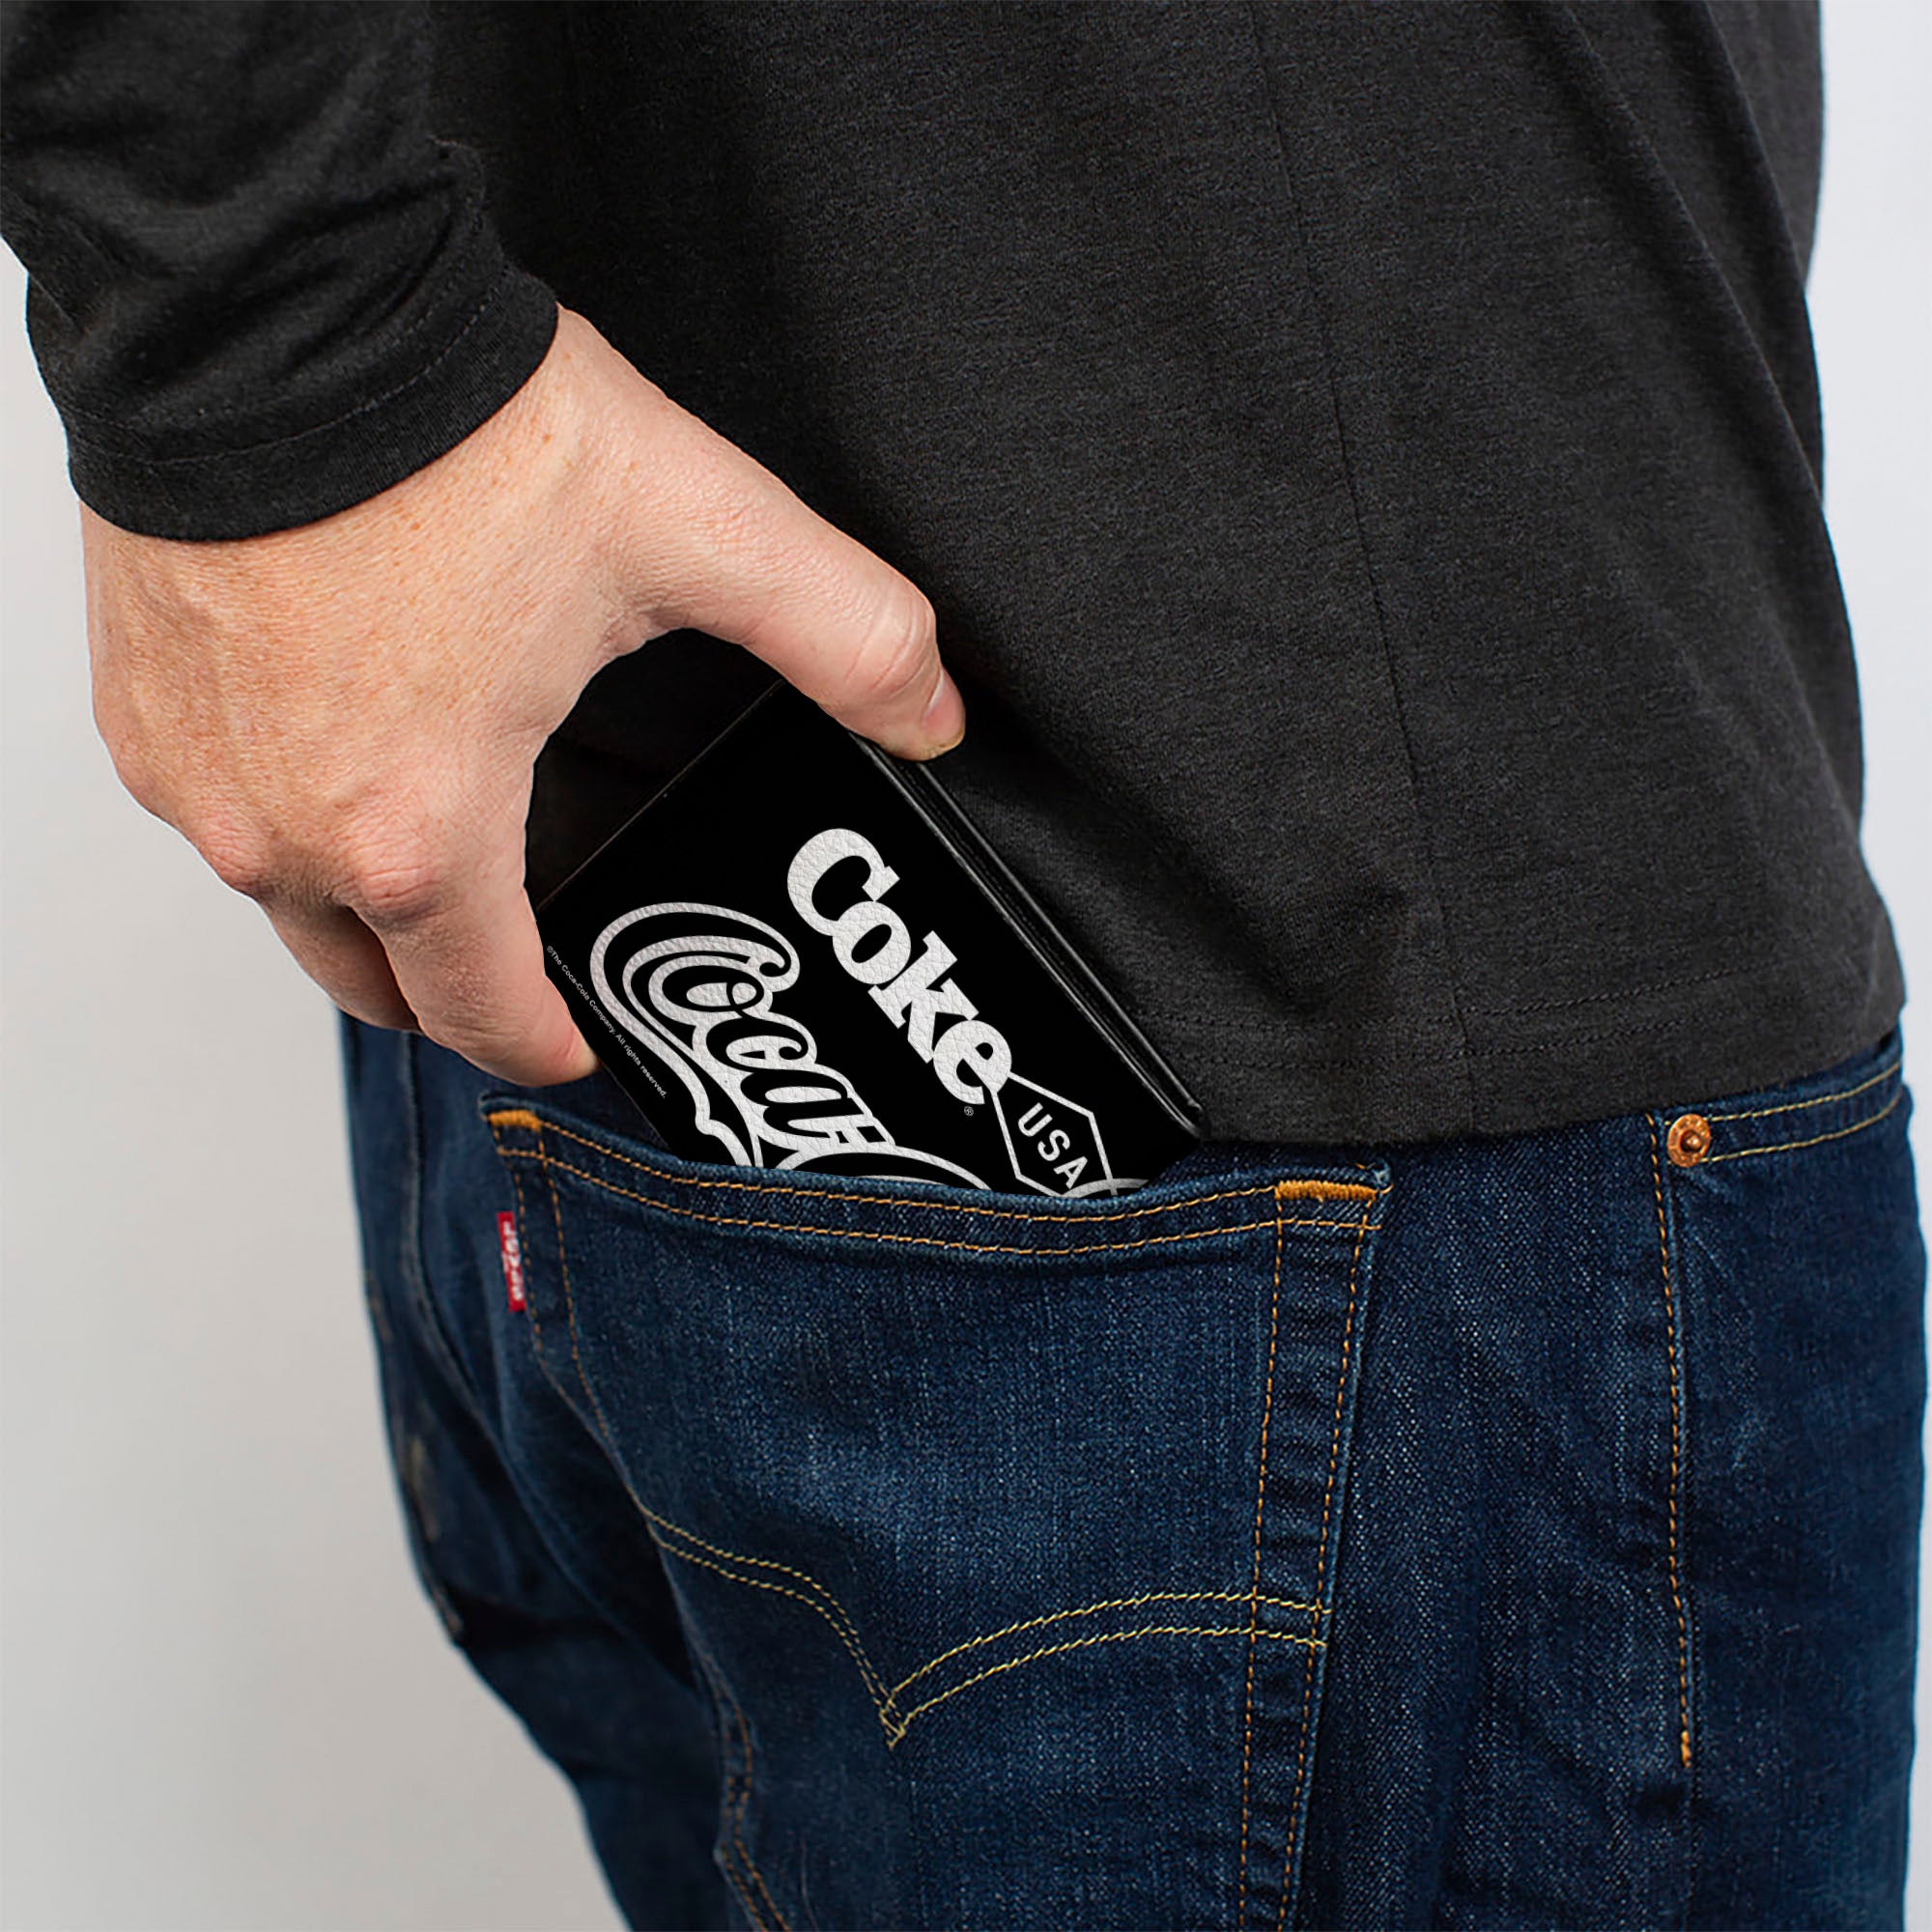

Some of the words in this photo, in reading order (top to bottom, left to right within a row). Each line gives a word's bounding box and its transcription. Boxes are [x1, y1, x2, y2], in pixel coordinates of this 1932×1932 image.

[561, 965, 590, 1001] Coca-Cola
[589, 1000, 616, 1035] Company.
[615, 1034, 626, 1046] All
[624, 1044, 641, 1066] rights
[640, 1065, 668, 1099] reserved.
[787, 829, 1011, 1104] Coke
[1018, 1102, 1088, 1189] USA
